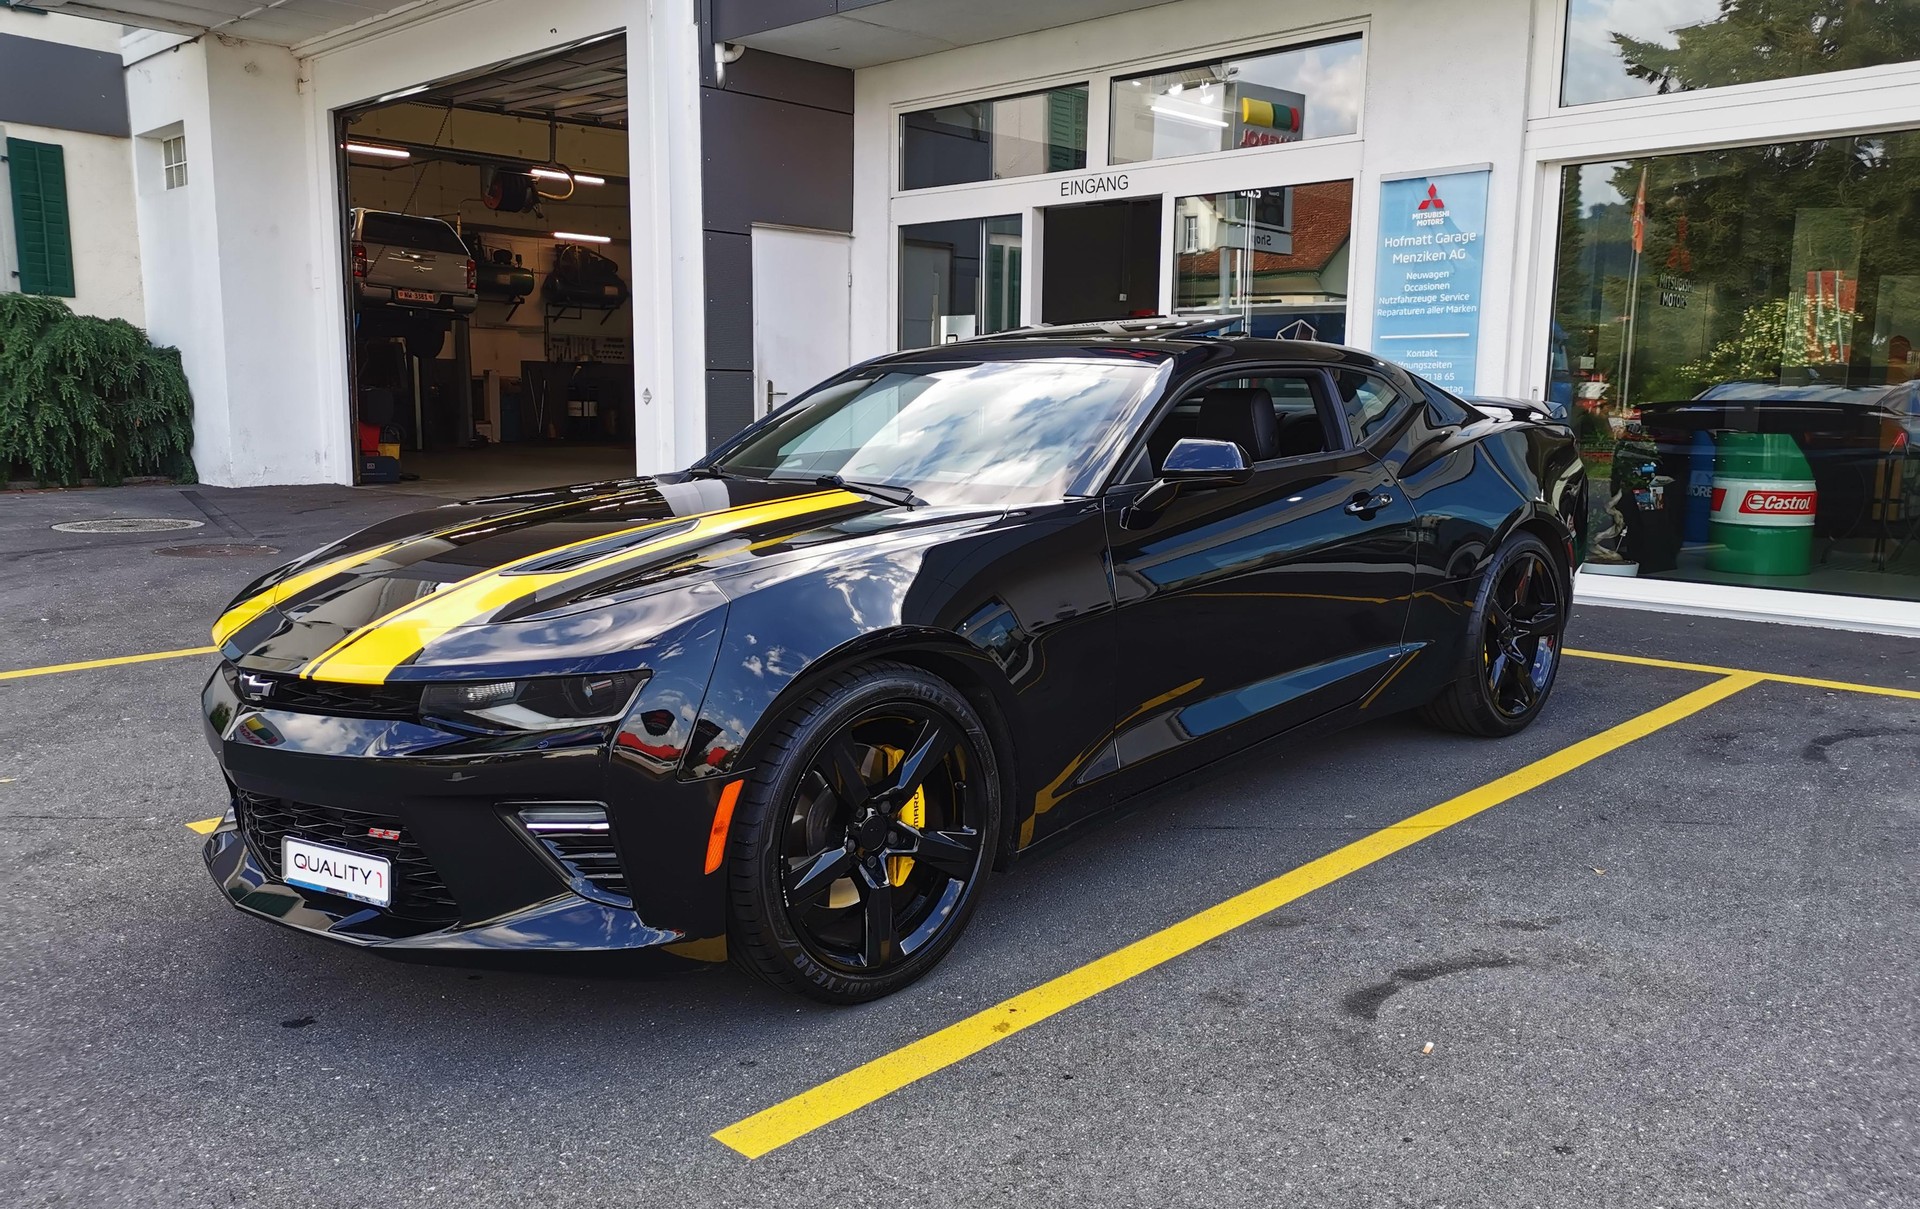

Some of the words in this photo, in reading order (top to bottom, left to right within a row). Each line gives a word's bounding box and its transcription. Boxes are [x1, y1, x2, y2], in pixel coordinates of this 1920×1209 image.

[1060, 174, 1129, 197] EINGANG
[1411, 210, 1450, 220] MITSUBISHI
[1416, 217, 1444, 227] MOTORS
[1384, 234, 1433, 248] Hofmatt
[1435, 231, 1477, 245] Garage
[1392, 250, 1446, 264] Menziken
[1449, 248, 1466, 260] AG
[1406, 271, 1450, 280] Neuwagen
[1404, 282, 1450, 292] Occasionen
[1378, 294, 1437, 305] Nutzfahrzeuge
[1440, 293, 1470, 302] Service
[1377, 307, 1425, 318] Reparaturen
[1427, 305, 1444, 315] aller
[1446, 304, 1477, 314] Marken
[1406, 349, 1439, 358] Kontakt
[1394, 361, 1453, 371] ffnungszeiten
[1444, 372, 1455, 381] 65
[1764, 494, 1811, 511] Castrol
[293, 852, 373, 885] QUALITY
